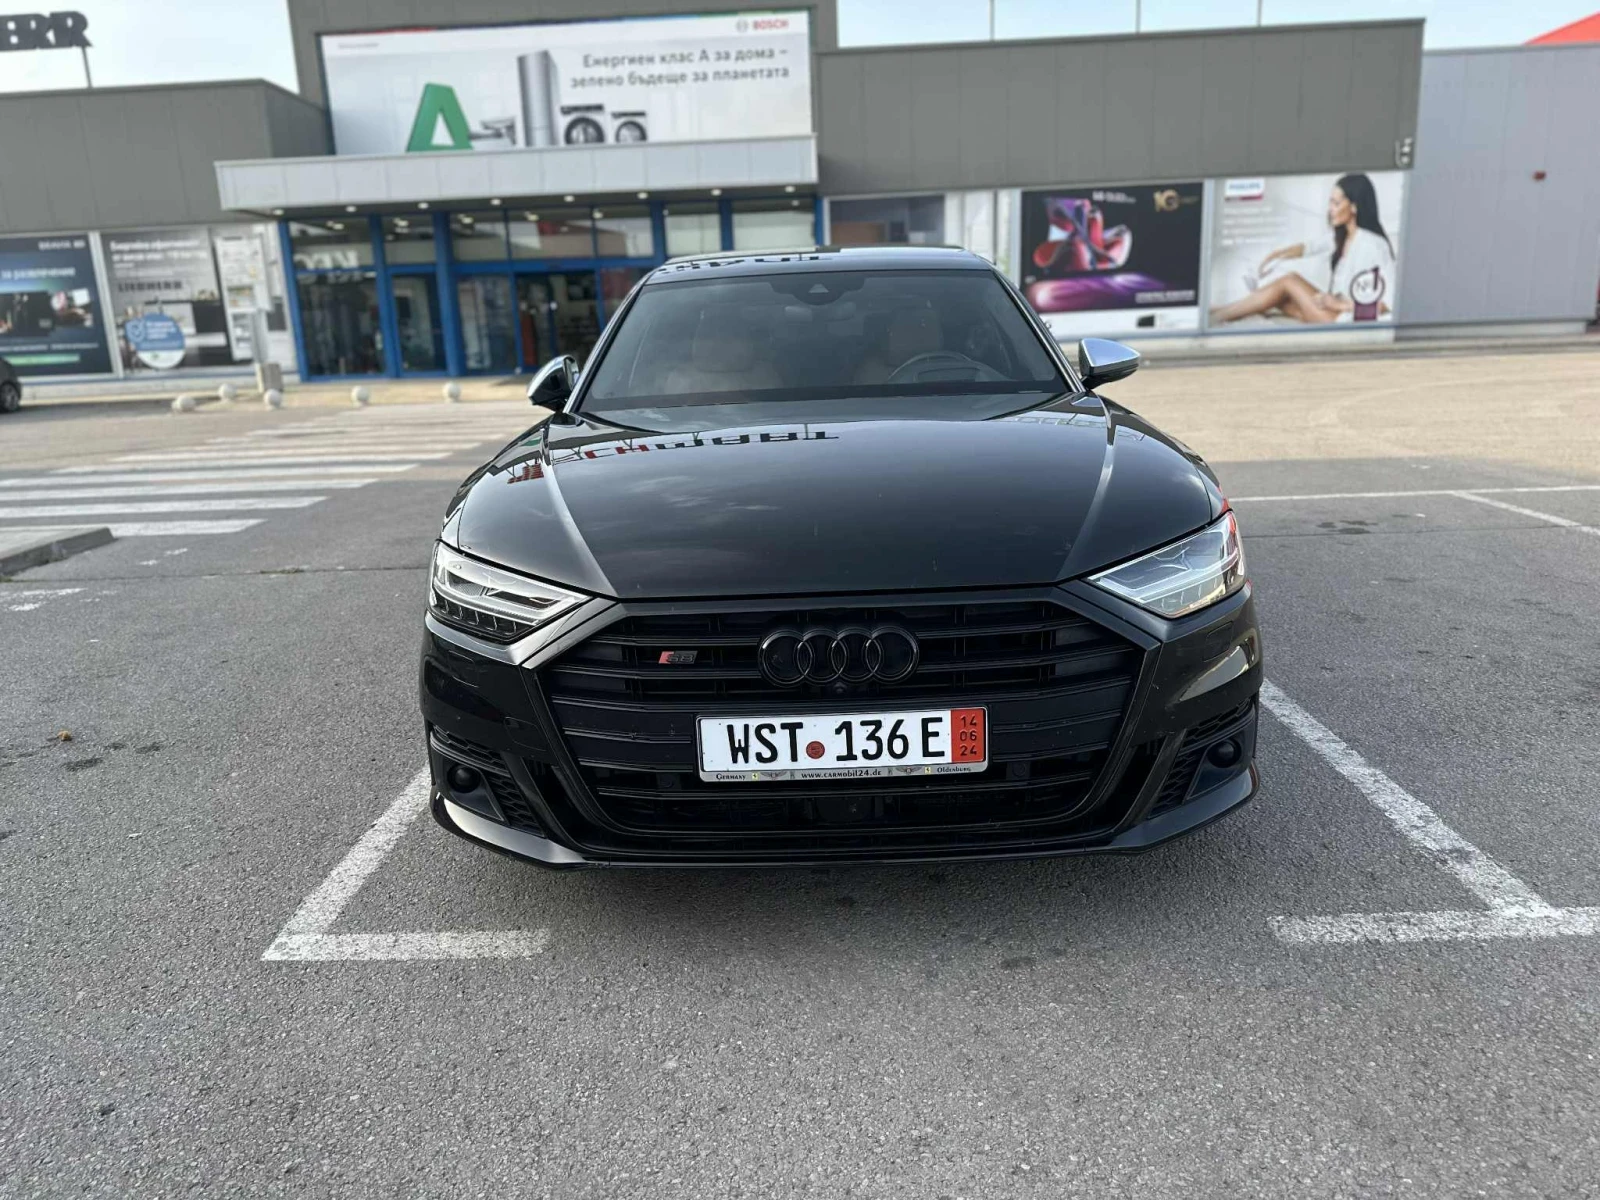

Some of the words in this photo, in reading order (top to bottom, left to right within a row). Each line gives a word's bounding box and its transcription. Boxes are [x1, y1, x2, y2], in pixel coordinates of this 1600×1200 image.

[752, 19, 789, 30] BOSCH
[660, 51, 694, 64] клас
[714, 50, 731, 62] за
[734, 48, 775, 63] дома
[570, 75, 624, 89] зелено
[692, 71, 708, 82] за
[712, 67, 790, 81] планетата
[959, 713, 978, 728] 14
[726, 721, 804, 764] WST
[834, 719, 909, 761] 136
[921, 716, 945, 758] E
[959, 728, 978, 742] 06
[959, 743, 978, 757] 24
